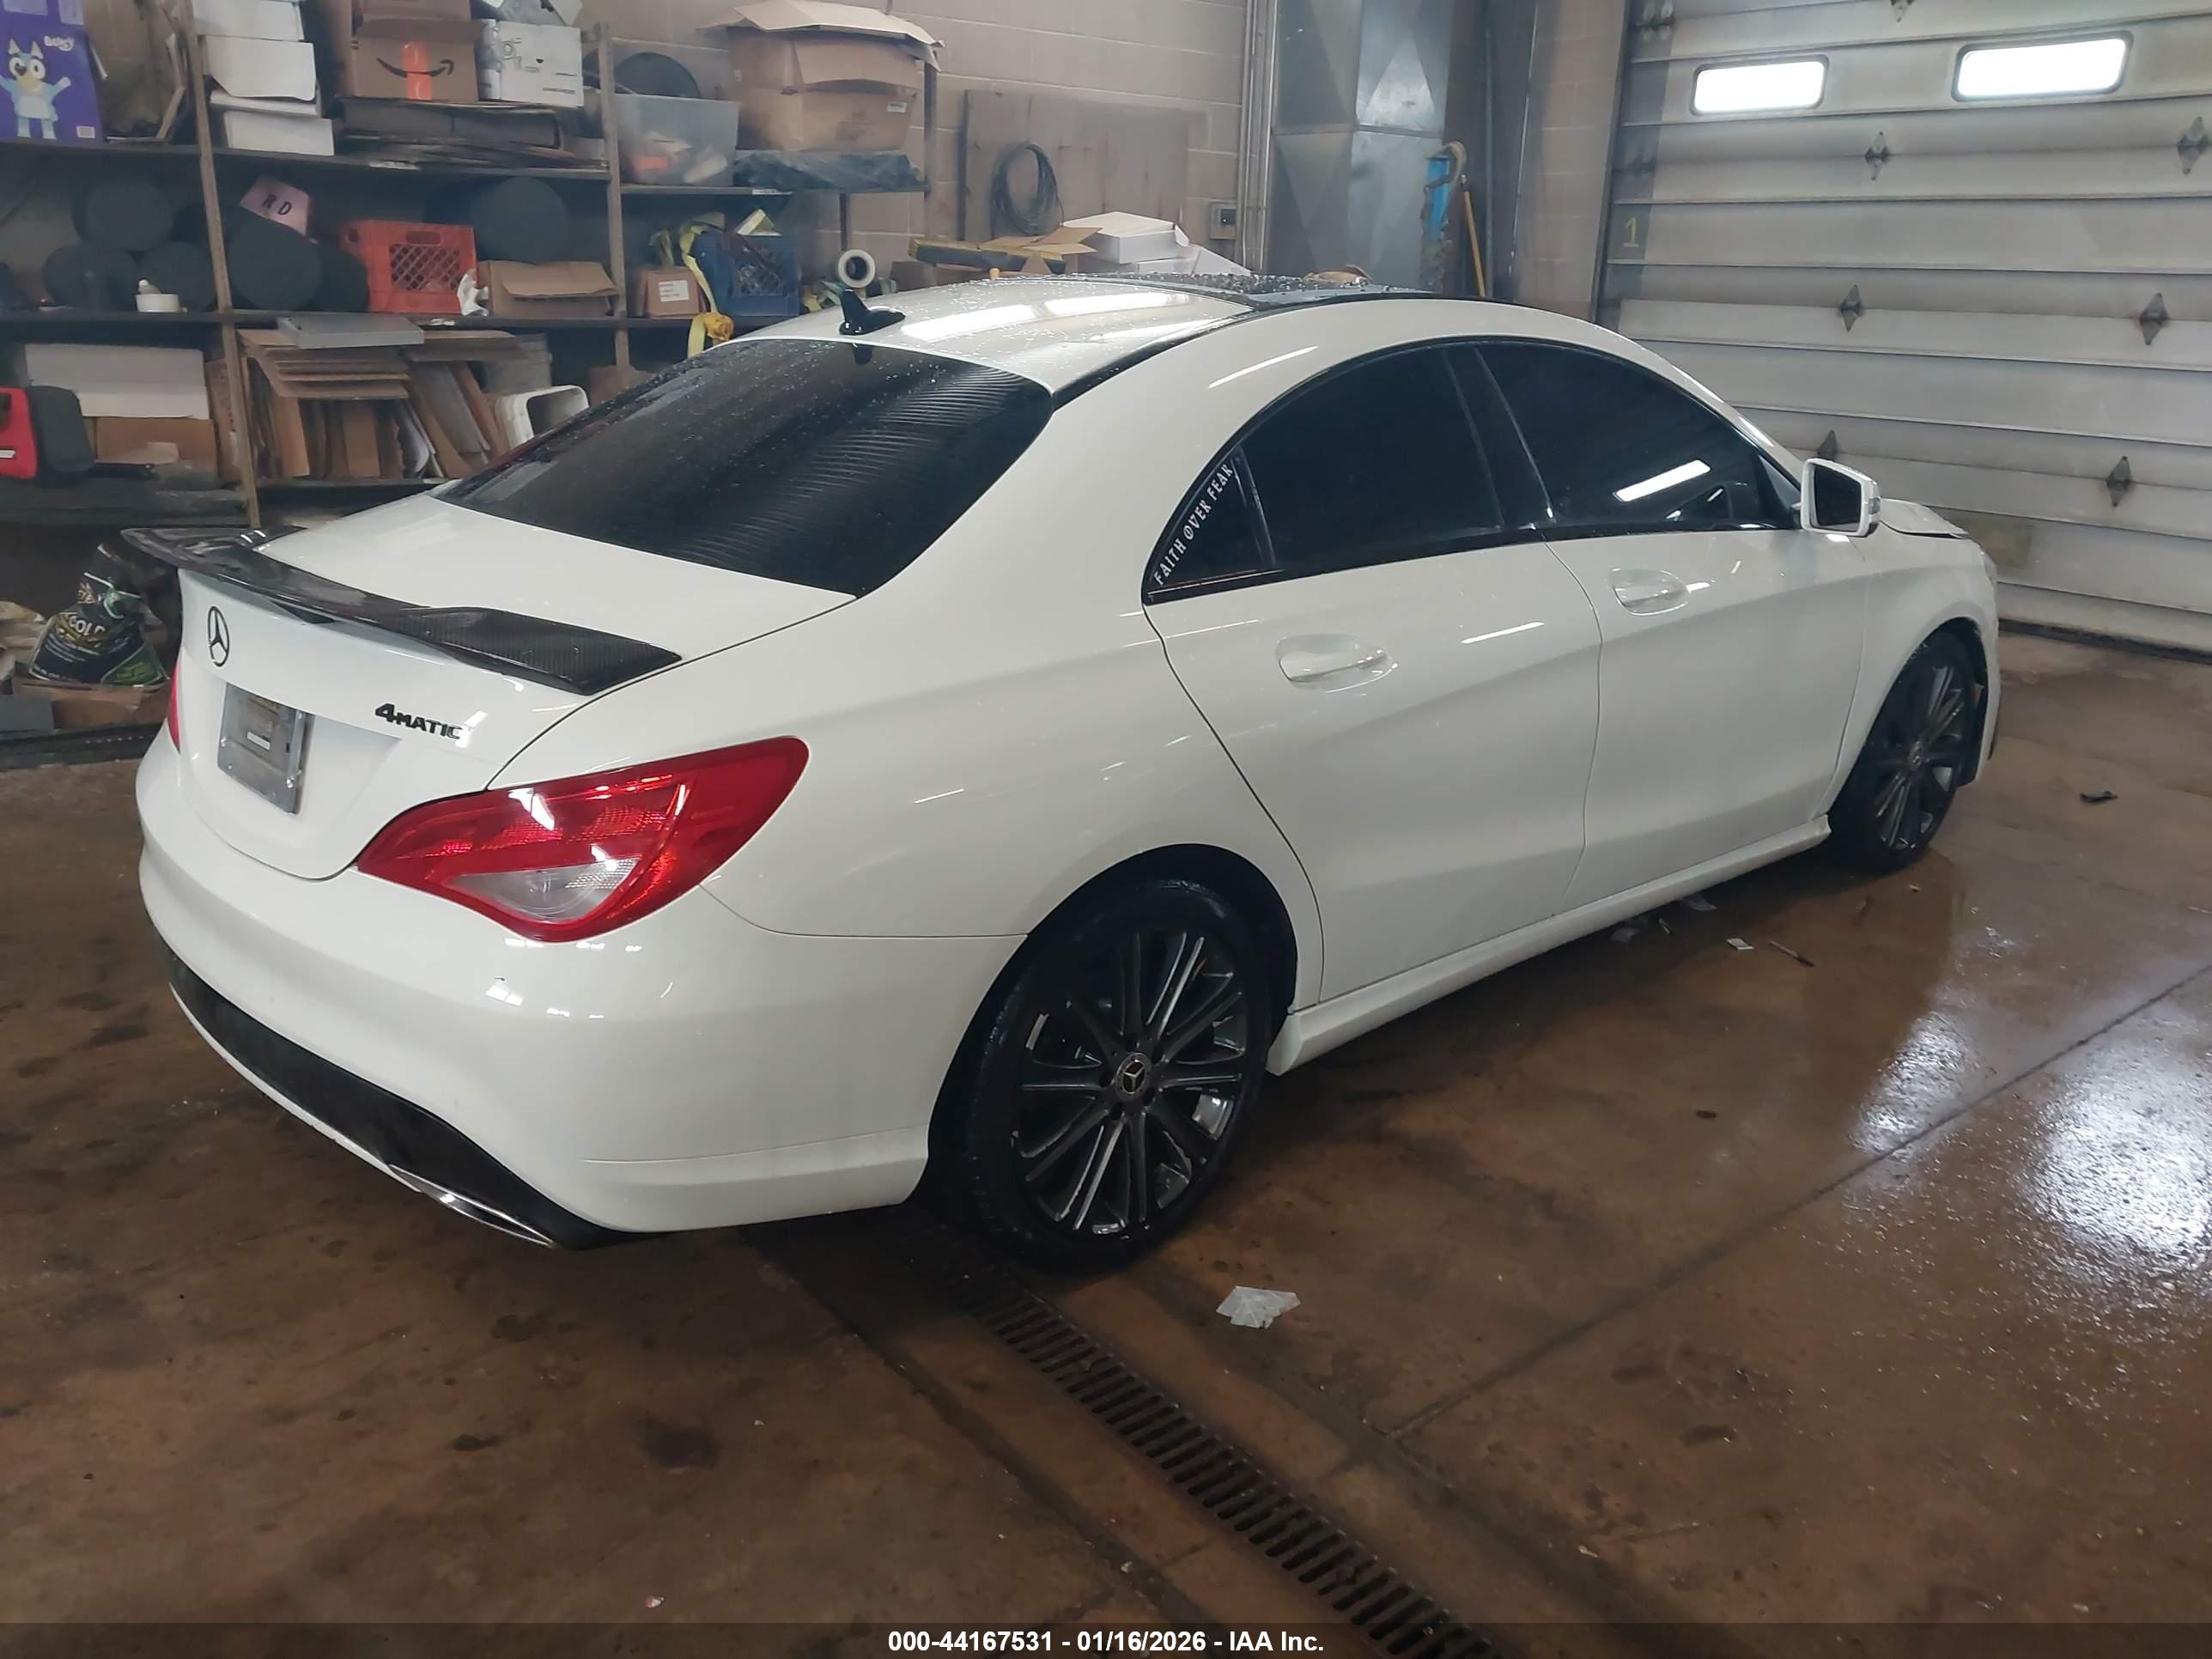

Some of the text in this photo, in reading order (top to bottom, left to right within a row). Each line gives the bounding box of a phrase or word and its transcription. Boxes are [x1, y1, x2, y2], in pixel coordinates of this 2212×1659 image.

[1624, 216, 1639, 248] 1
[1153, 464, 1233, 586] FAITH OVER FEAR
[374, 702, 464, 740] 4MATIC
